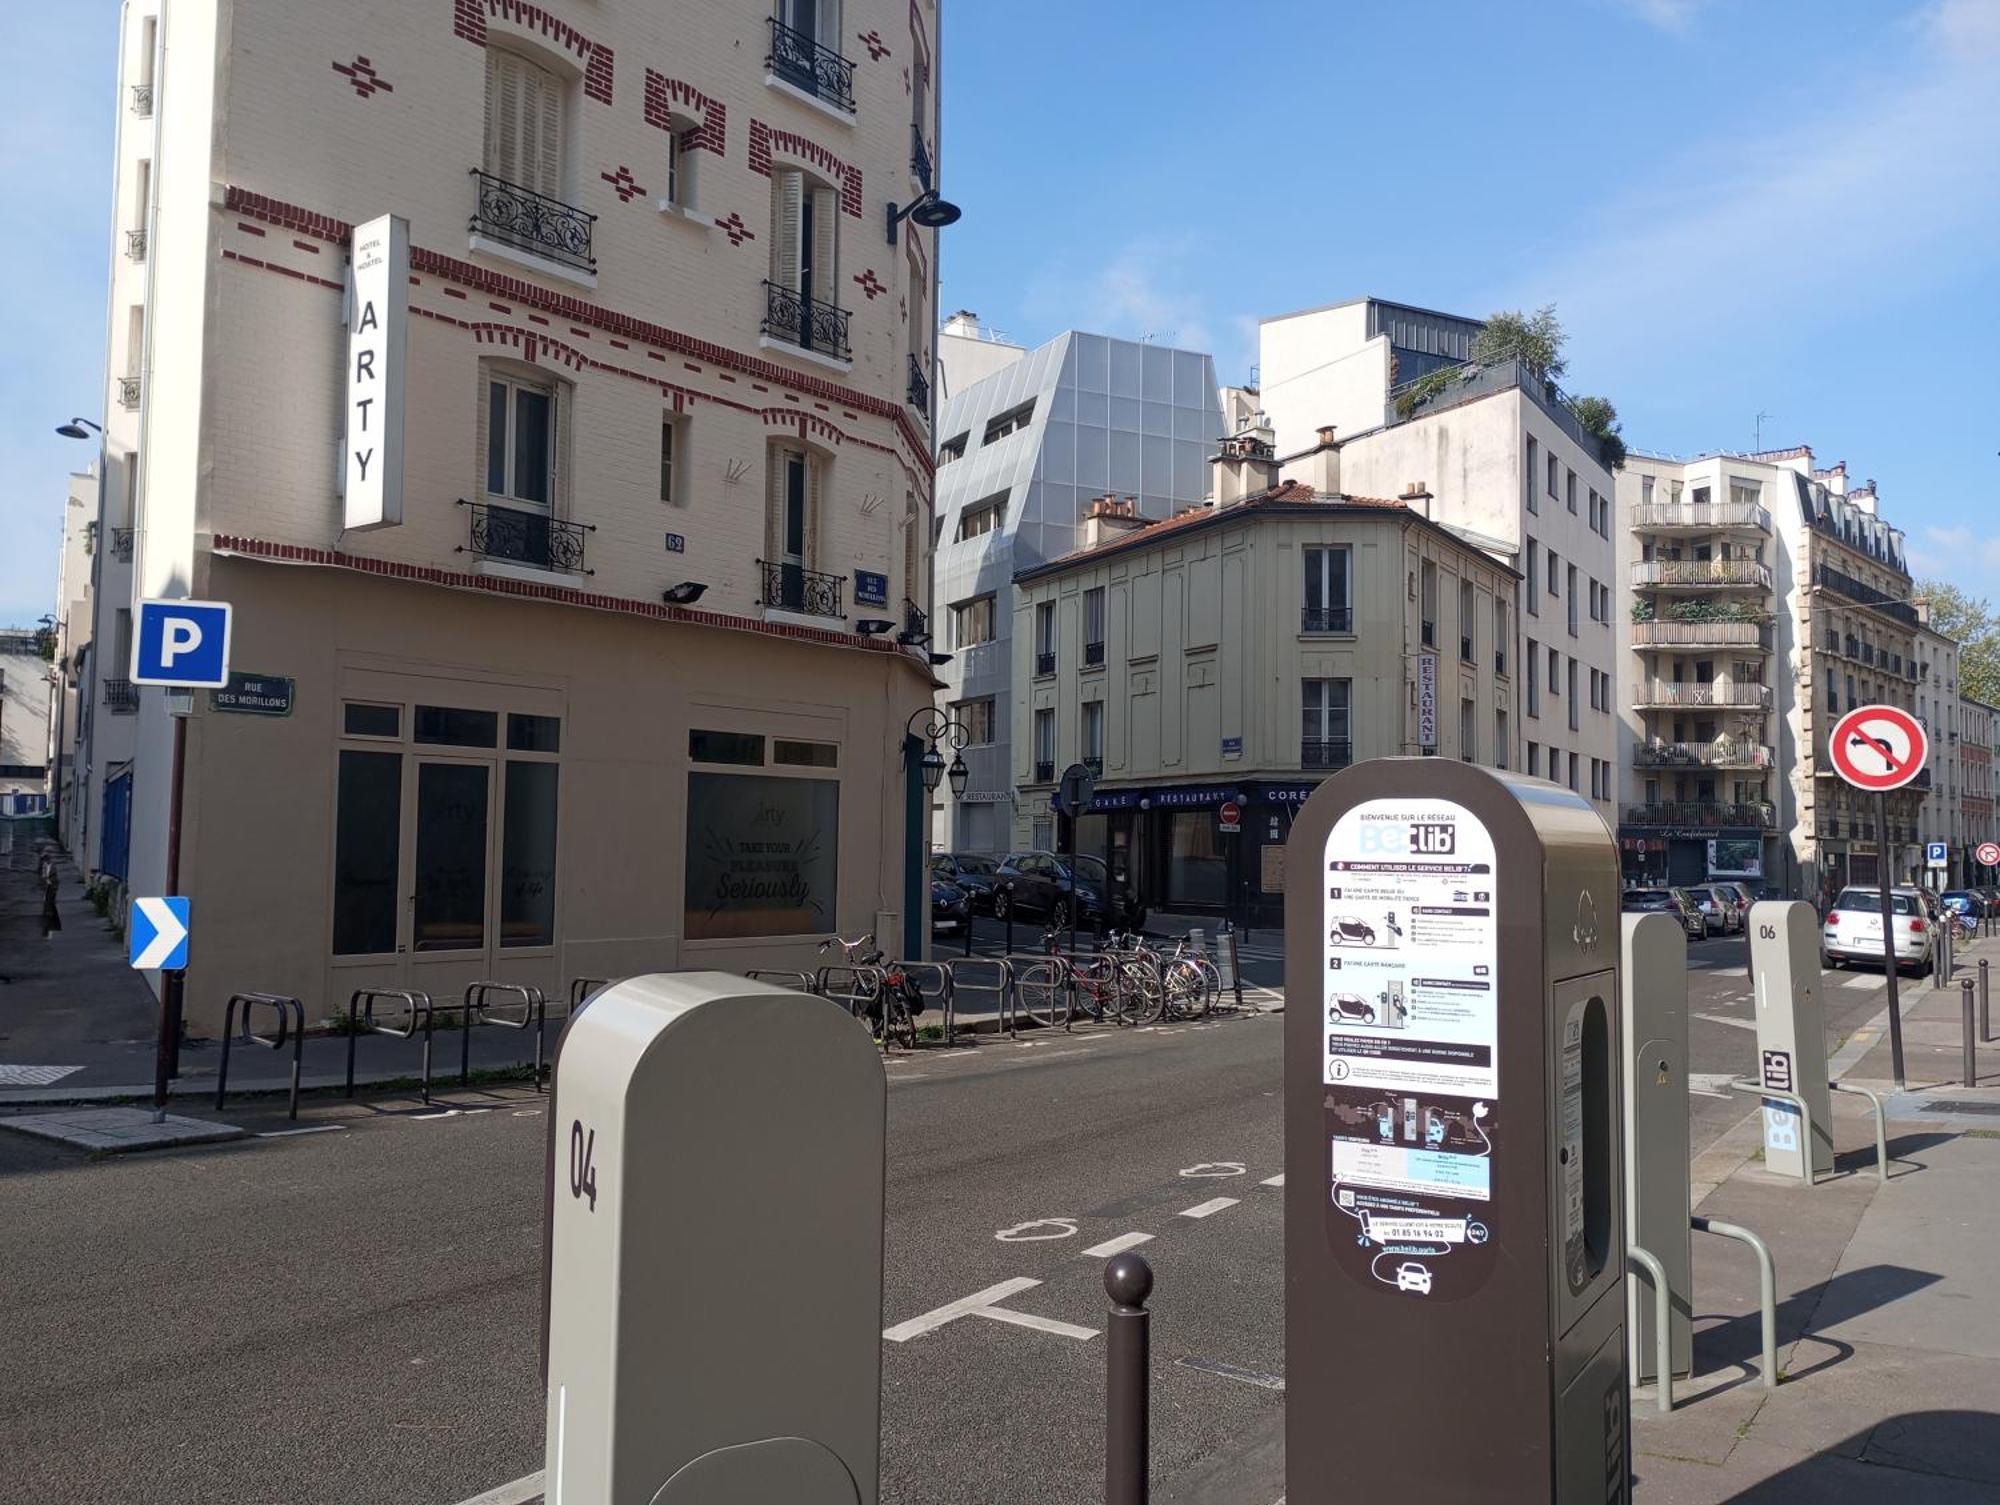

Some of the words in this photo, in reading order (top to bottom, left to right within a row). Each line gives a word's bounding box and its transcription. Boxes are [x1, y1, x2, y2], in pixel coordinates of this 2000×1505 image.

[355, 301, 378, 482] ARTY
[160, 617, 203, 668] P
[244, 682, 262, 692] RUE
[218, 693, 235, 703] DES
[238, 695, 286, 707] MORILLONS
[1421, 657, 1434, 742] RESTAURANT
[1932, 848, 1940, 858] P
[716, 872, 810, 907] Seriously
[1759, 925, 1776, 940] 06
[570, 1119, 597, 1213] 04
[1402, 1229, 1411, 1237] 85
[1413, 1229, 1421, 1237] 16
[1423, 1230, 1432, 1238] 94
[1434, 1230, 1444, 1238] 02
